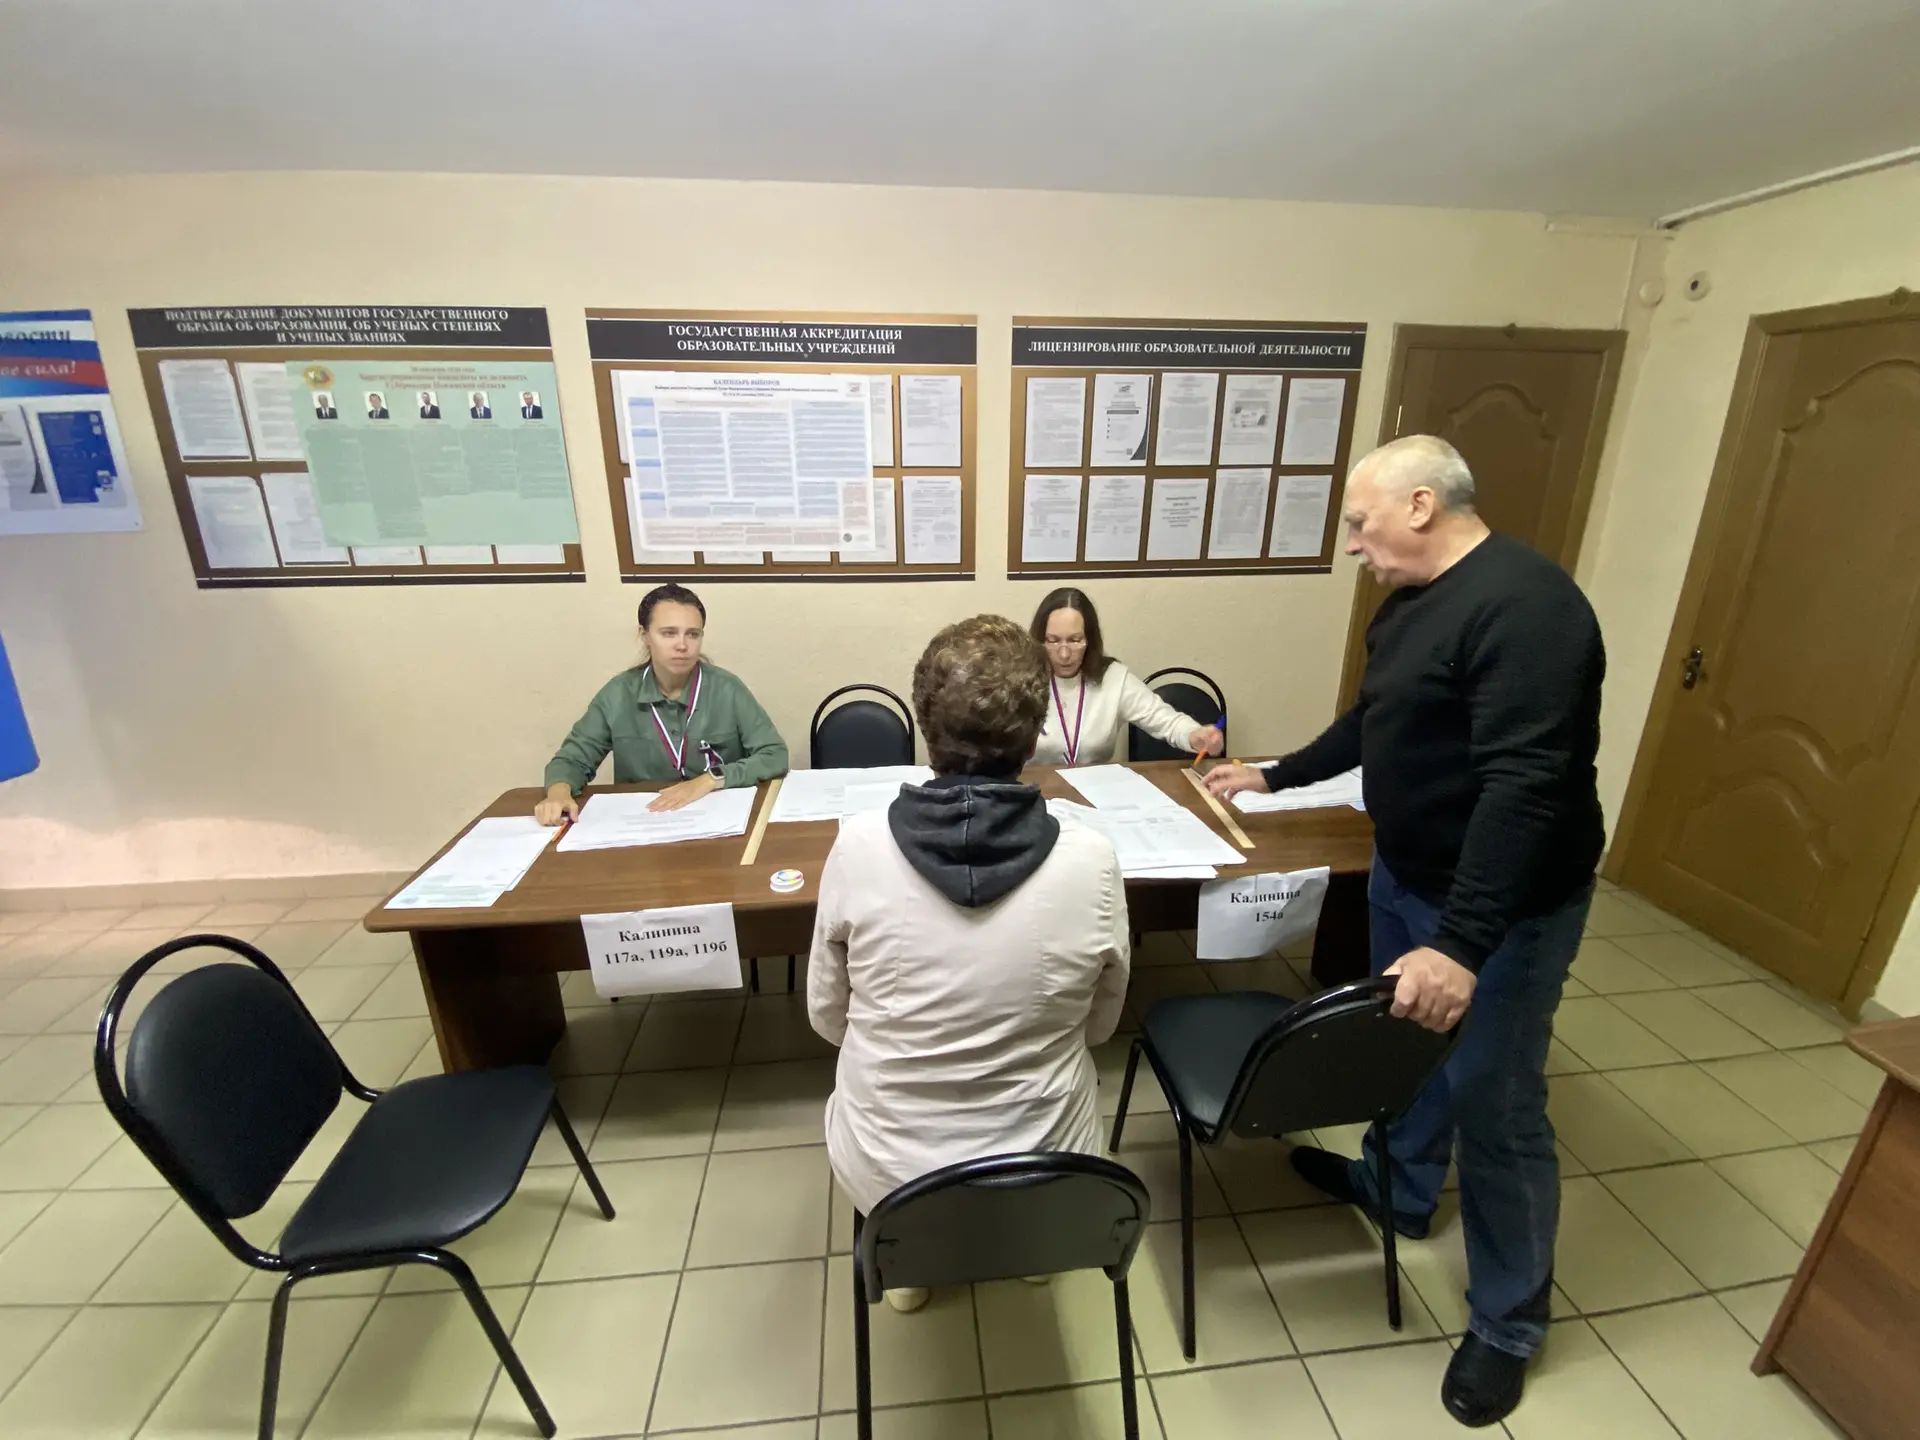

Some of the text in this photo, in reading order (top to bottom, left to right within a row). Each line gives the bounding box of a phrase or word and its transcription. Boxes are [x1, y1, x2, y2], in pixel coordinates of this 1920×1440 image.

[165, 308, 509, 321] ПОДТВЕРЖДЕНИЕ ДОКУМЕНТОВ ГОСУДАРСТВЕННОГО
[176, 320, 502, 332] ОБРАЗЦА ОБ ОБРАЗОВАНИИ, ОБ УЧЕНЫХ СТЕПЕНЯХ
[668, 325, 903, 341] ГОСУДАРСТВЕННАЯ АККРЕДИТАЦИЯ
[276, 332, 407, 343] И УЧЕНЫХ ЗВАНИЯХ
[676, 340, 896, 355] ОБРАЗОВАТЕЛЬНЫХ УЧРЕЖДЕНИЙ
[1028, 341, 1351, 356] ЛИЦЕНЗИРОВАНИЕ ОБРАЗОВАТЕЛЬНОЙ ДЕЯТЕЛЬНОСТИ
[1230, 889, 1301, 904] Калинина
[1255, 910, 1284, 922] 154а
[618, 924, 701, 942] Калинина
[605, 940, 728, 965] 117а, 119а, 119б
